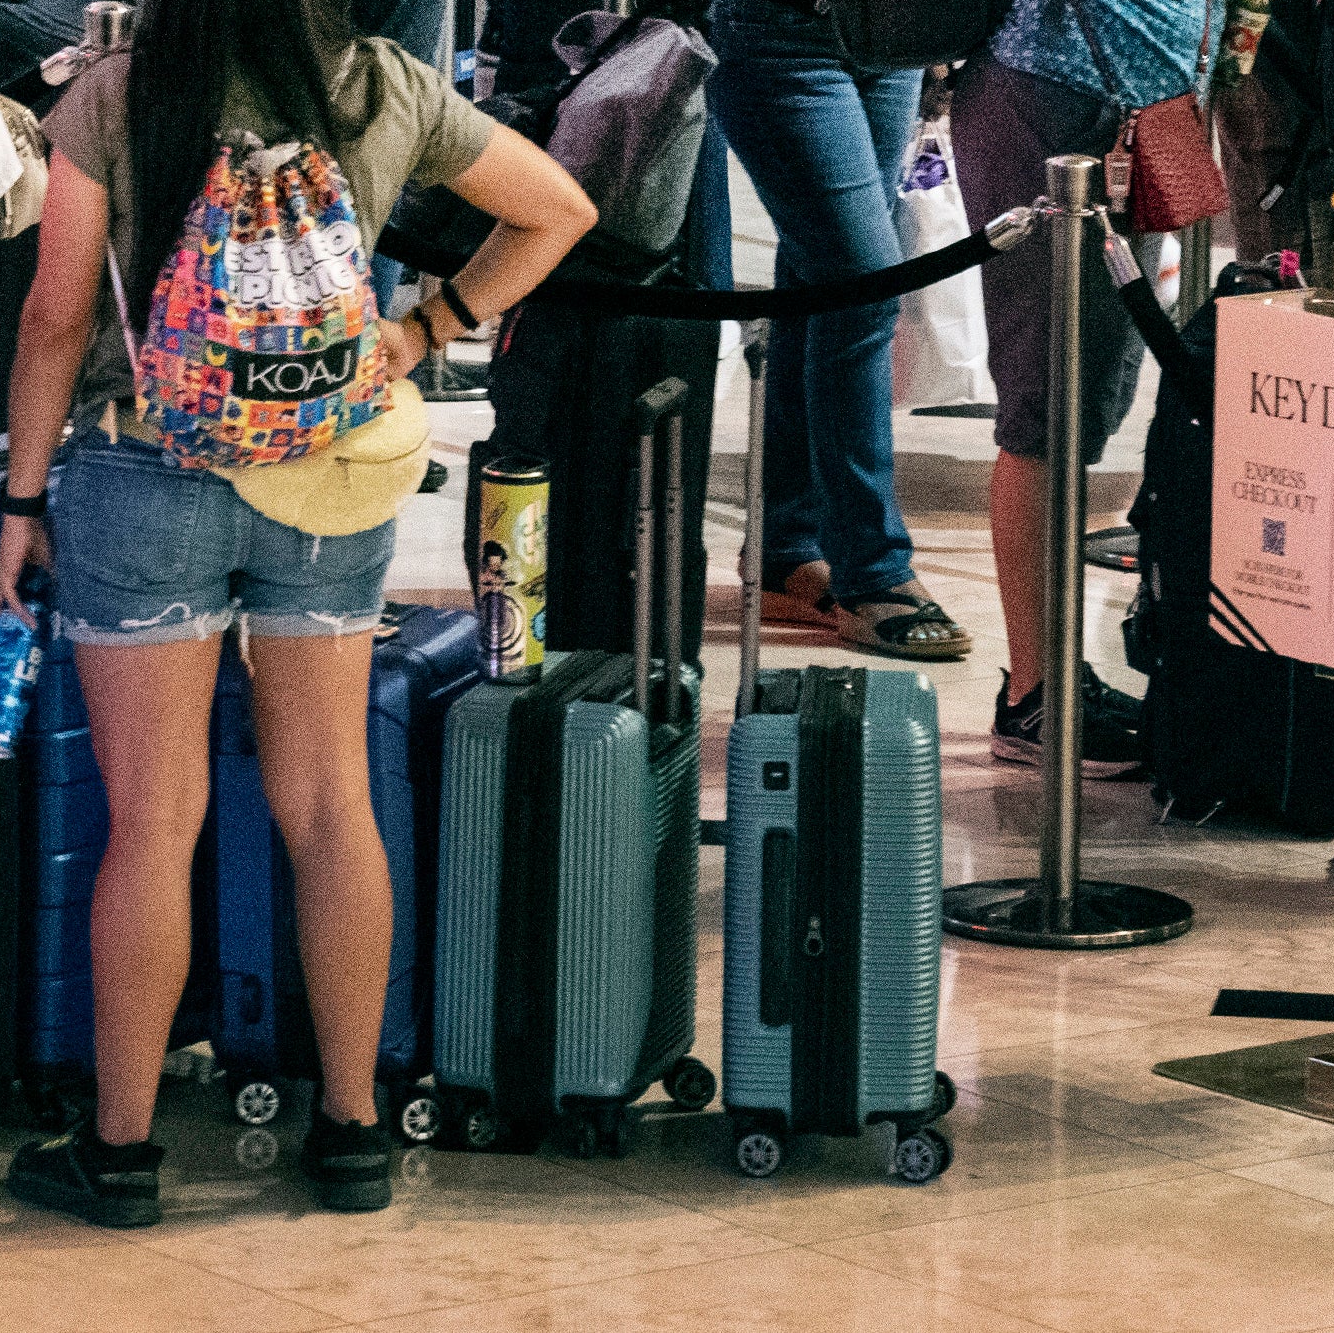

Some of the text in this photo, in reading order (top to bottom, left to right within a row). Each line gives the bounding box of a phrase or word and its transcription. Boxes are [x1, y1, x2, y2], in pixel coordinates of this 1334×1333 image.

[247, 350, 352, 393] KOAJ
[1250, 371, 1317, 423] KEY
[1245, 461, 1307, 490] EXPRESS
